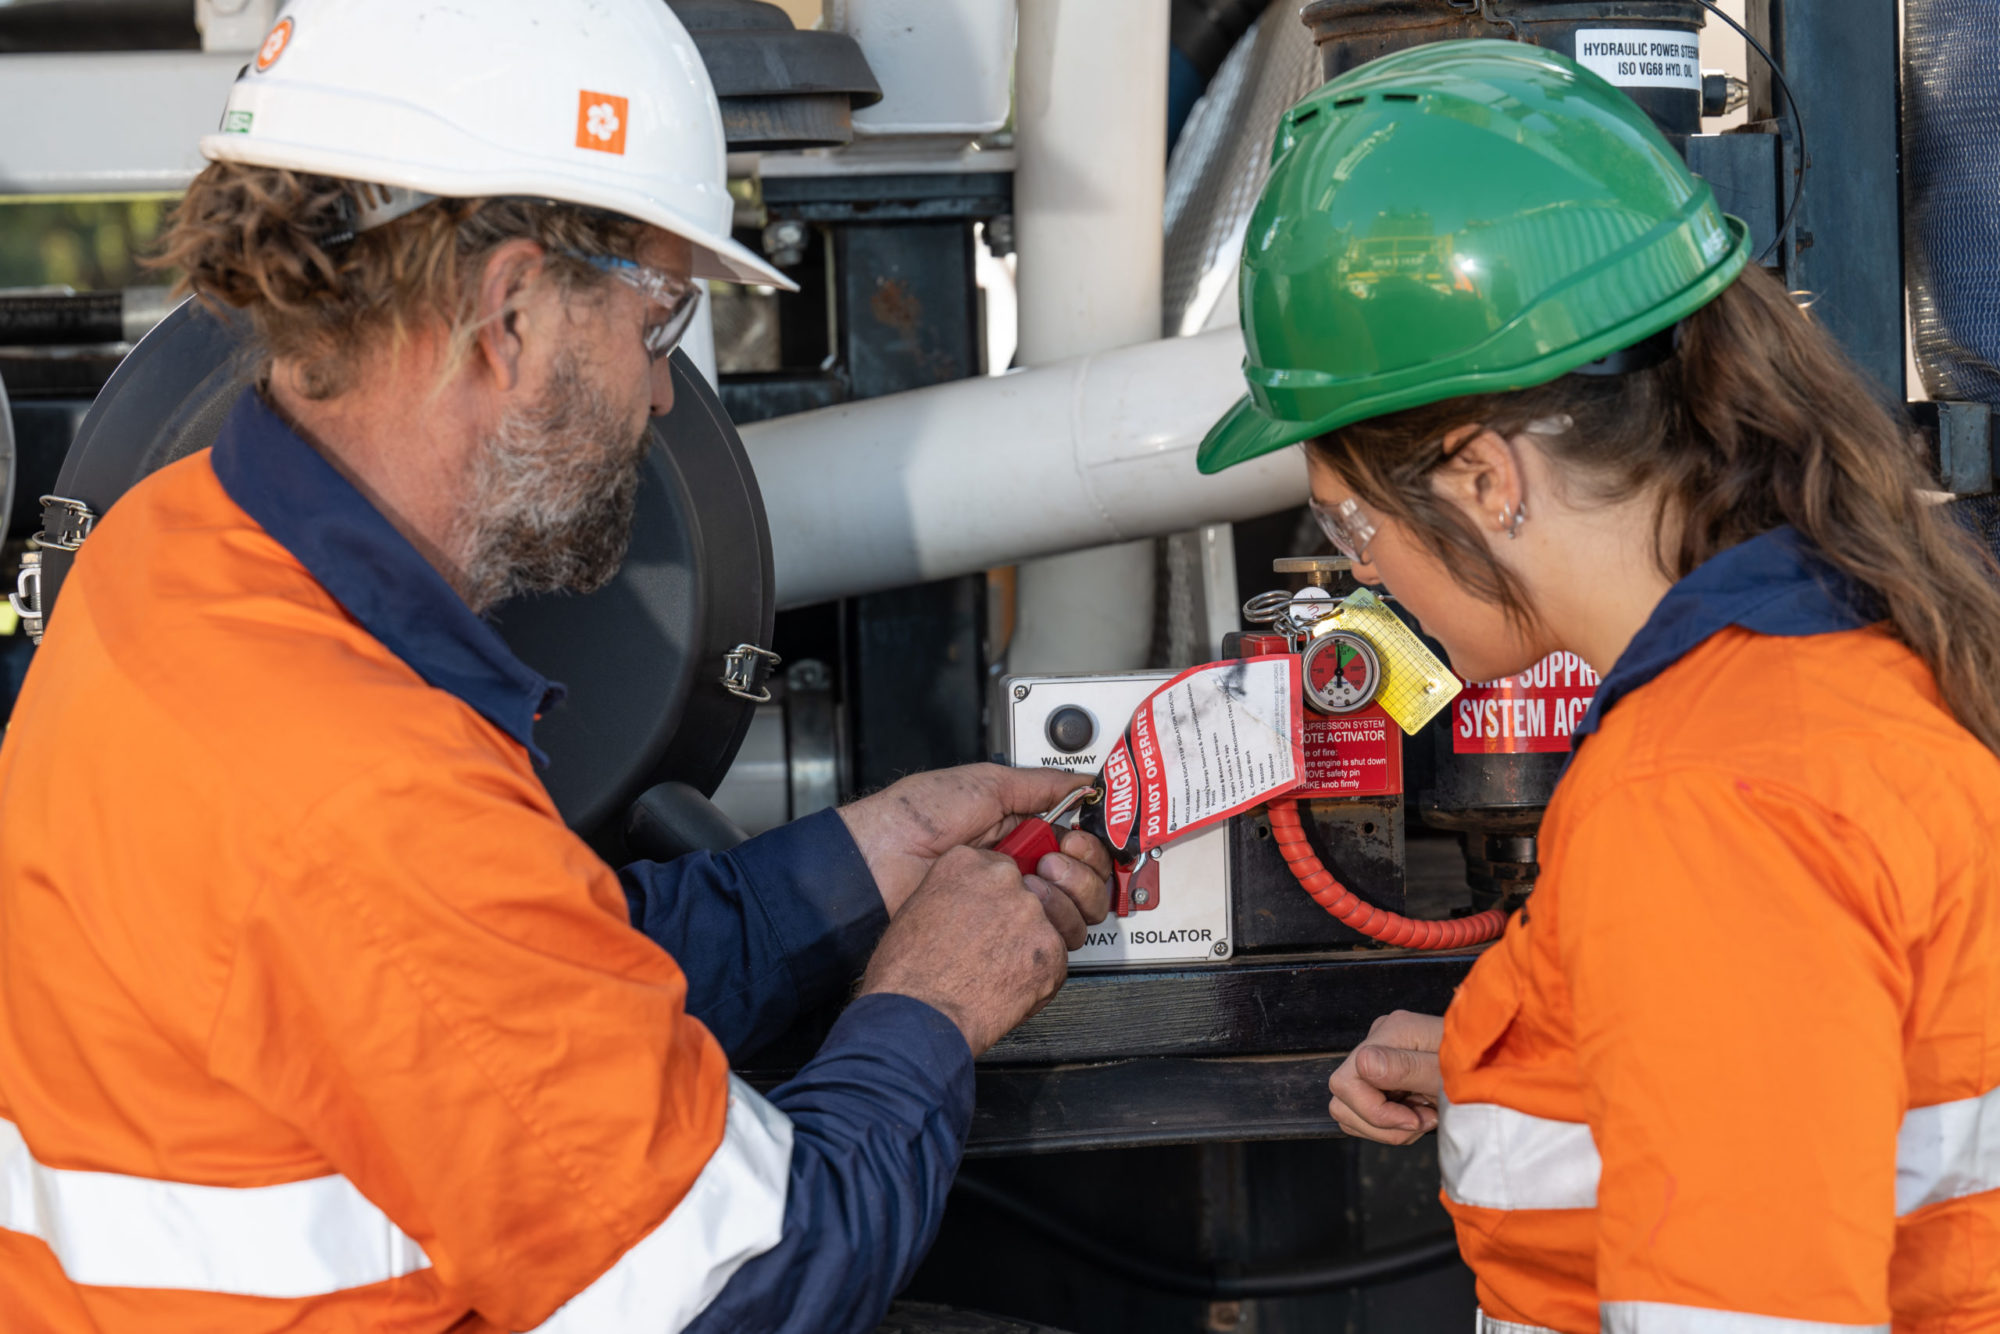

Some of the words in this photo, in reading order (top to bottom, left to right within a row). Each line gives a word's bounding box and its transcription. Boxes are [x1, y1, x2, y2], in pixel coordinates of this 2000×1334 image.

[1584, 42, 1648, 56] HYDRAULIC
[1650, 44, 1680, 58] POWER
[1618, 62, 1636, 75] ISO
[1640, 62, 1663, 76] VG68
[1666, 63, 1682, 77] HYD.
[1395, 622, 1425, 653] MAINTENANCE
[1425, 652, 1443, 672] RECORD
[1352, 720, 1385, 729] SYSTEM
[1459, 698, 1546, 738] SYSTEM
[1172, 716, 1182, 746] ISOLATION
[1231, 719, 1239, 755] Effectiveness
[1327, 730, 1385, 743] ACTIVATOR
[1137, 708, 1157, 779] OPERATE
[1041, 755, 1096, 766] WALKWAY
[1317, 760, 1340, 768] engine
[1327, 770, 1347, 778] safety
[1350, 769, 1360, 778] pin
[1107, 747, 1132, 825] DANGER
[1341, 780, 1359, 789] firmly
[1148, 783, 1160, 813] NOT
[1148, 816, 1160, 836] DO
[1130, 929, 1212, 944] ISOLATOR
